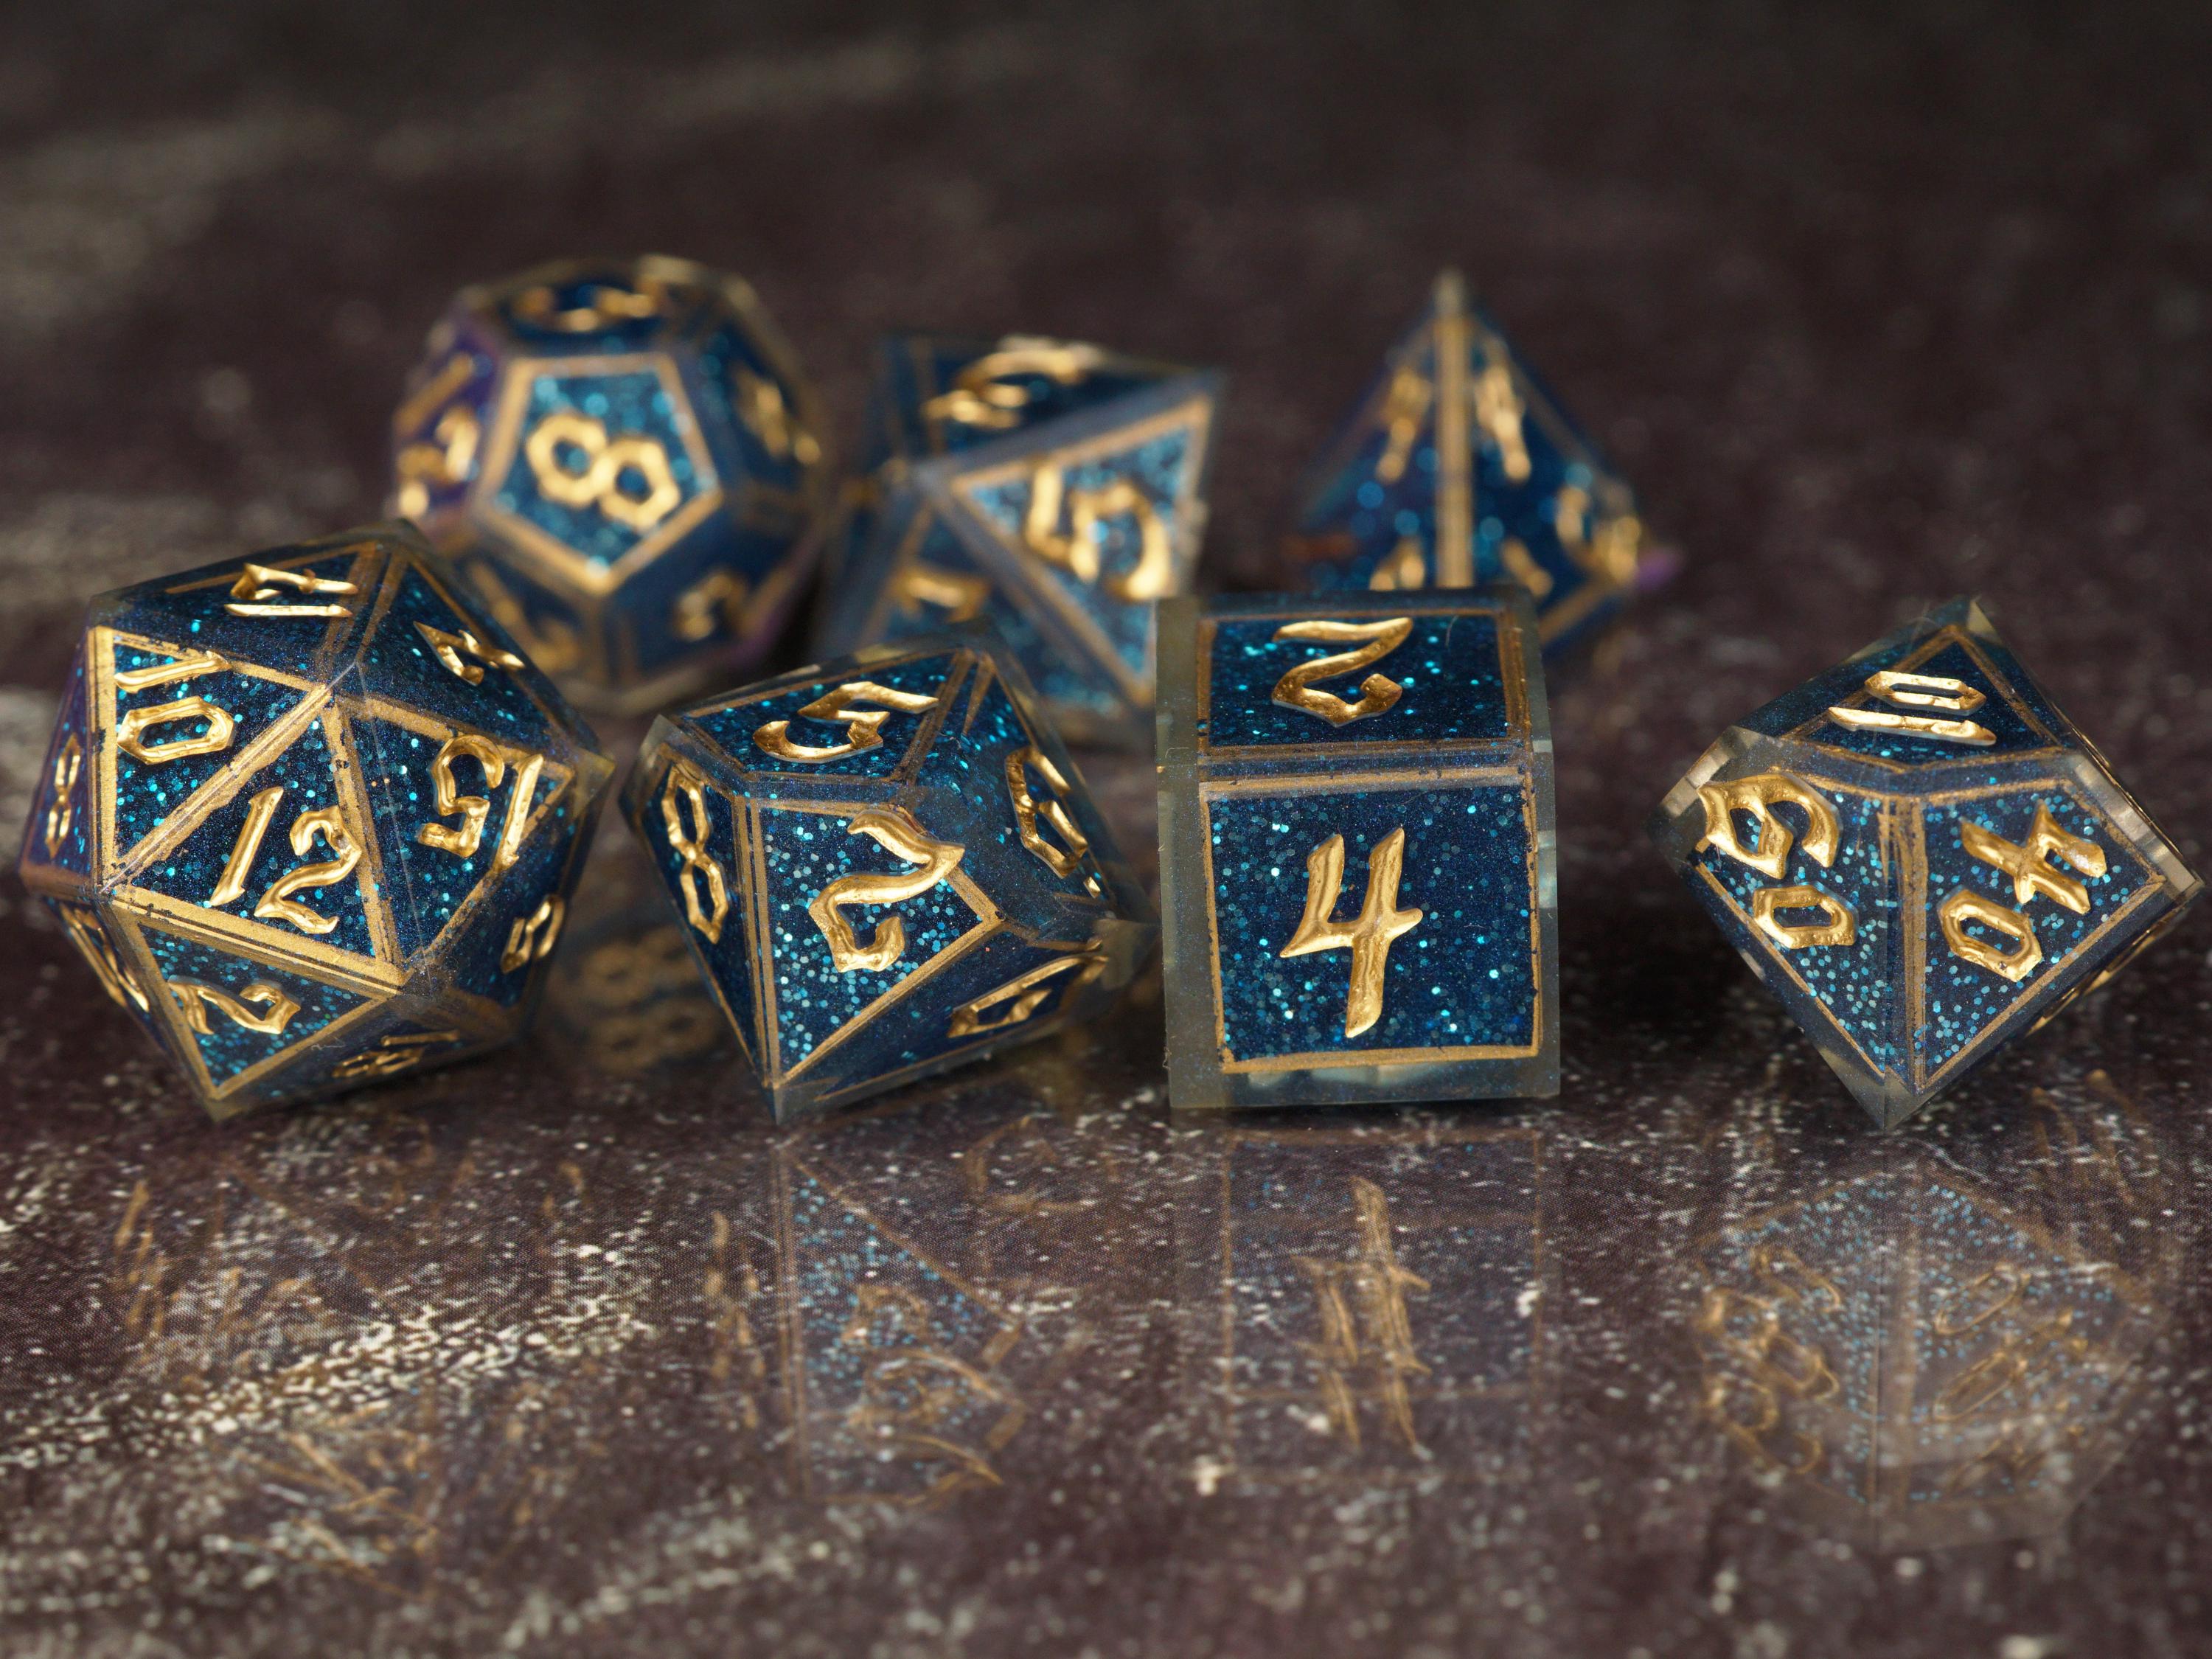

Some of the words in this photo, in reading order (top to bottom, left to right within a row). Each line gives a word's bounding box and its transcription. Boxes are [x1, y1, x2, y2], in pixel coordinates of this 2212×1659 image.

[526, 409, 680, 531] 8
[1027, 459, 1174, 603] 5
[114, 650, 235, 765] 10
[752, 681, 940, 764] 5
[1271, 616, 1414, 728] 2
[1827, 669, 1997, 747] 10
[44, 734, 80, 858] 8
[209, 786, 363, 935] 12
[418, 734, 544, 871] 15
[661, 764, 729, 946] 8
[808, 810, 967, 973] 2
[1280, 827, 1425, 1039] 4
[1939, 800, 2107, 984] 40
[167, 975, 302, 1035] 2
